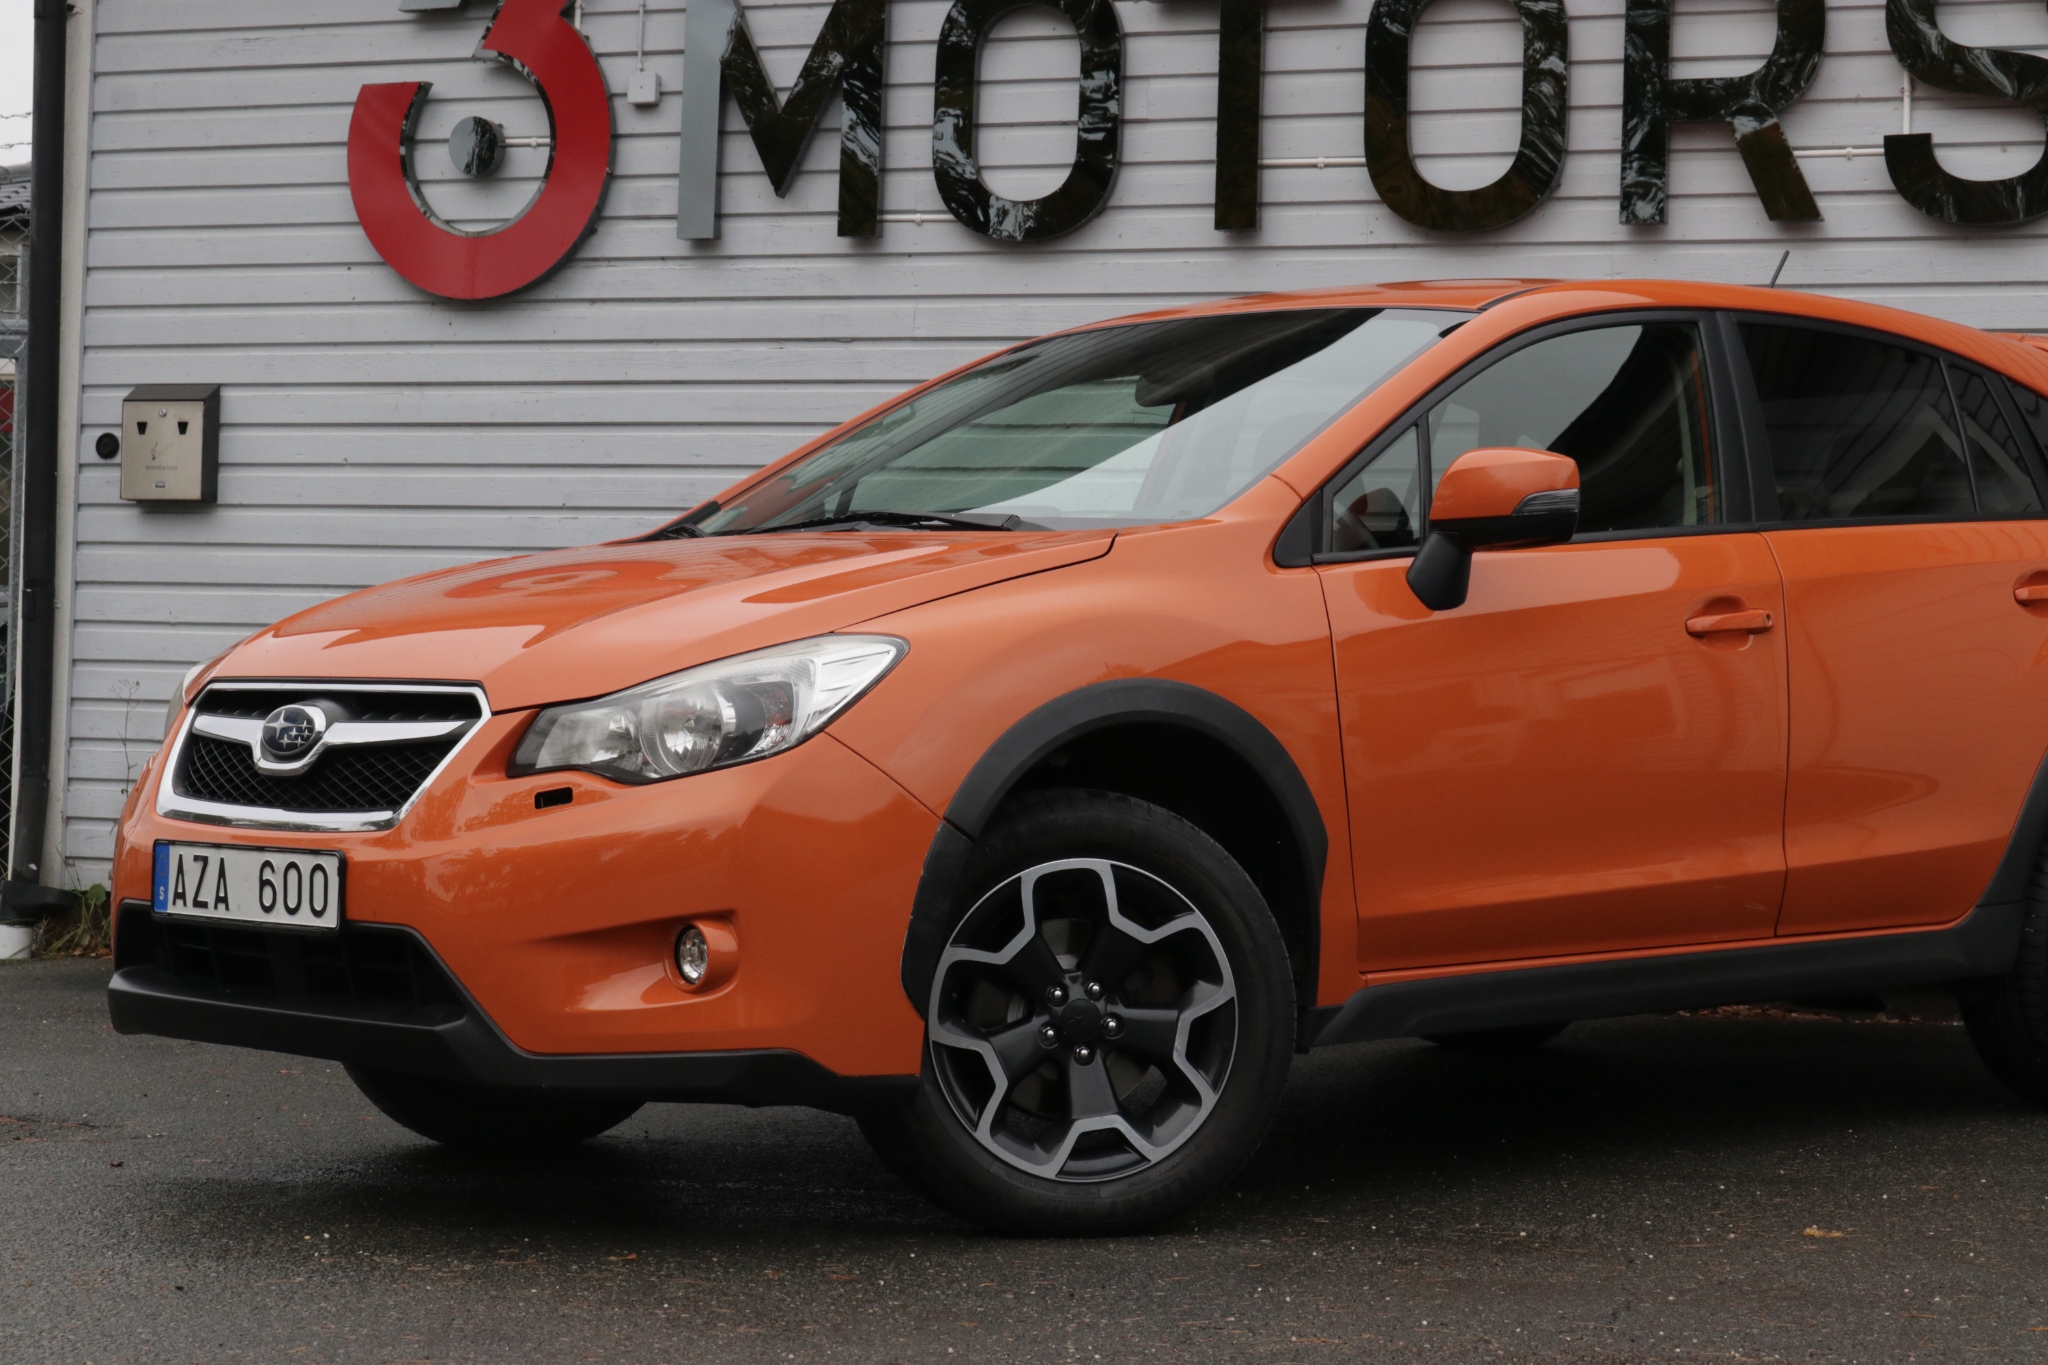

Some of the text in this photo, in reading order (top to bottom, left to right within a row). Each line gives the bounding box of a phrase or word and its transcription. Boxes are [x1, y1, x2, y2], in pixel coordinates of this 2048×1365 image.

[677, 0, 2048, 244] MOTORS
[158, 887, 165, 900] S
[172, 854, 329, 918] AZA 600
